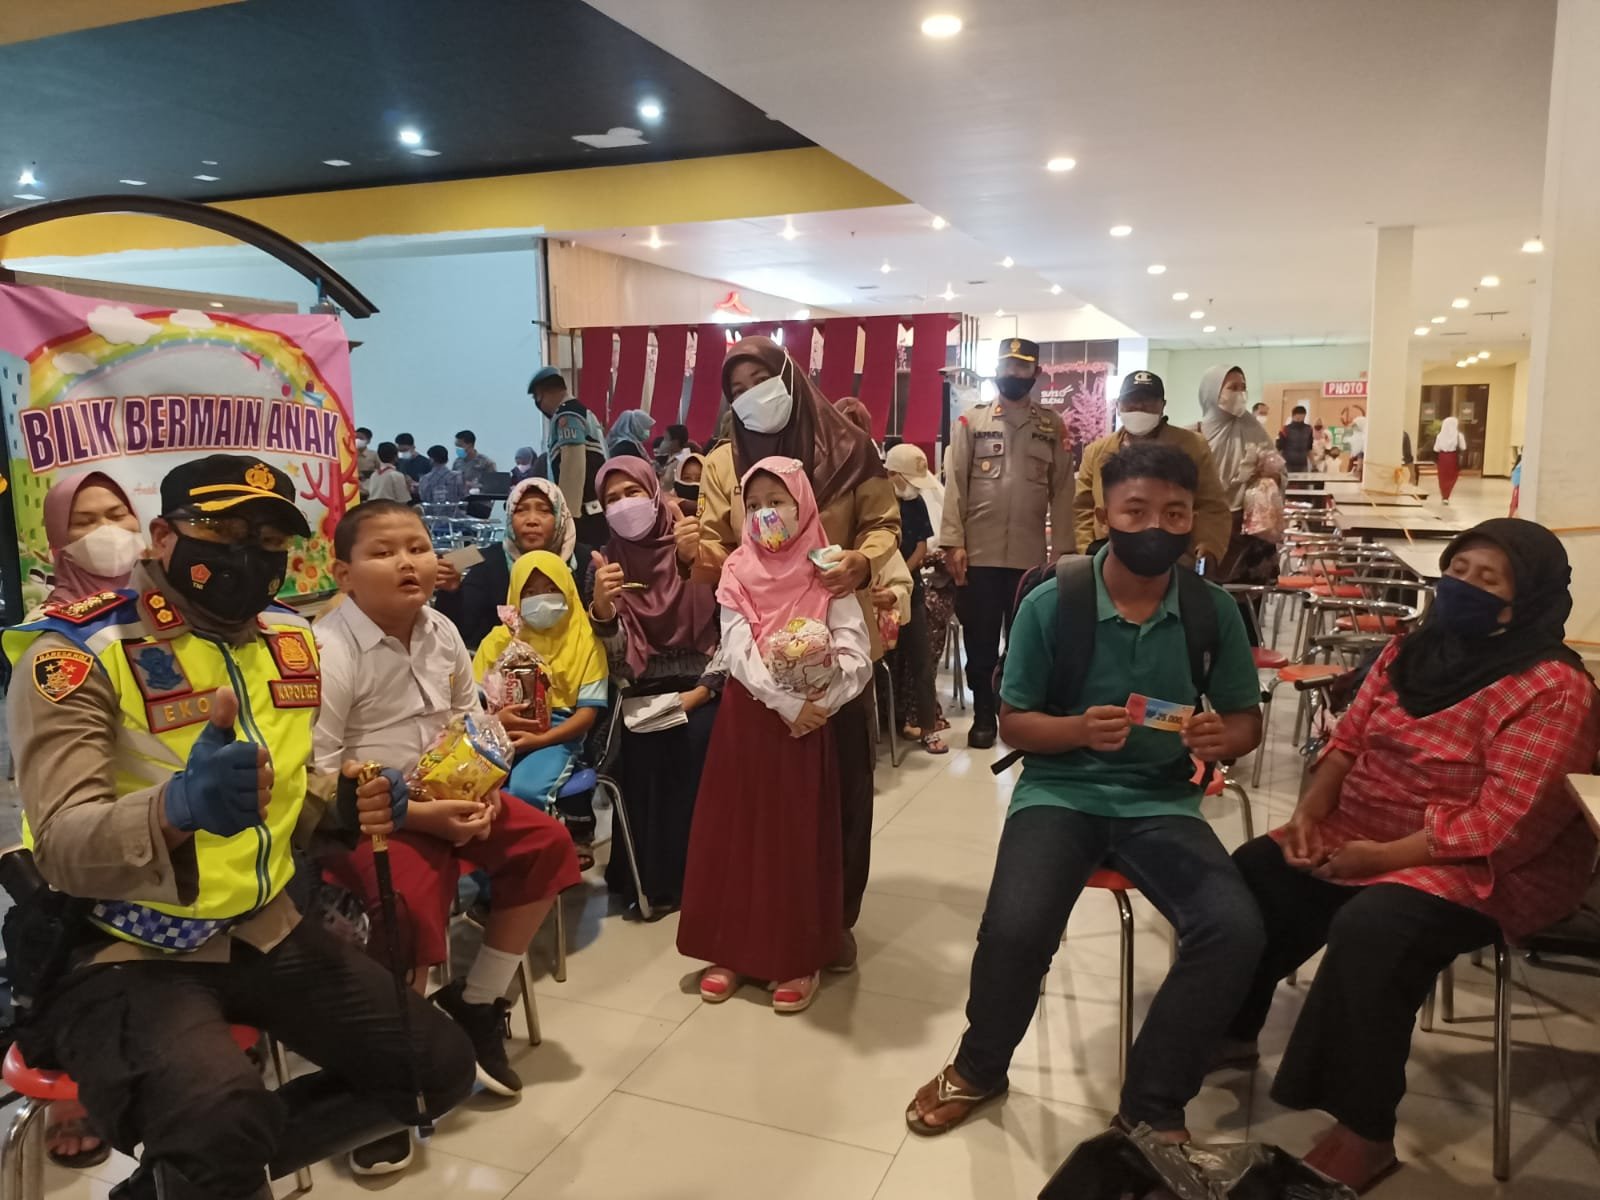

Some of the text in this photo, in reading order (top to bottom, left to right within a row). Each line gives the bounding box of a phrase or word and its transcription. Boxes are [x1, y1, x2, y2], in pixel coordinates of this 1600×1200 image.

[1328, 382, 1363, 395] PHOTO
[21, 396, 339, 472] BILIK BERMAIN ANAK
[503, 672, 519, 706] ango
[163, 697, 209, 722] EKO
